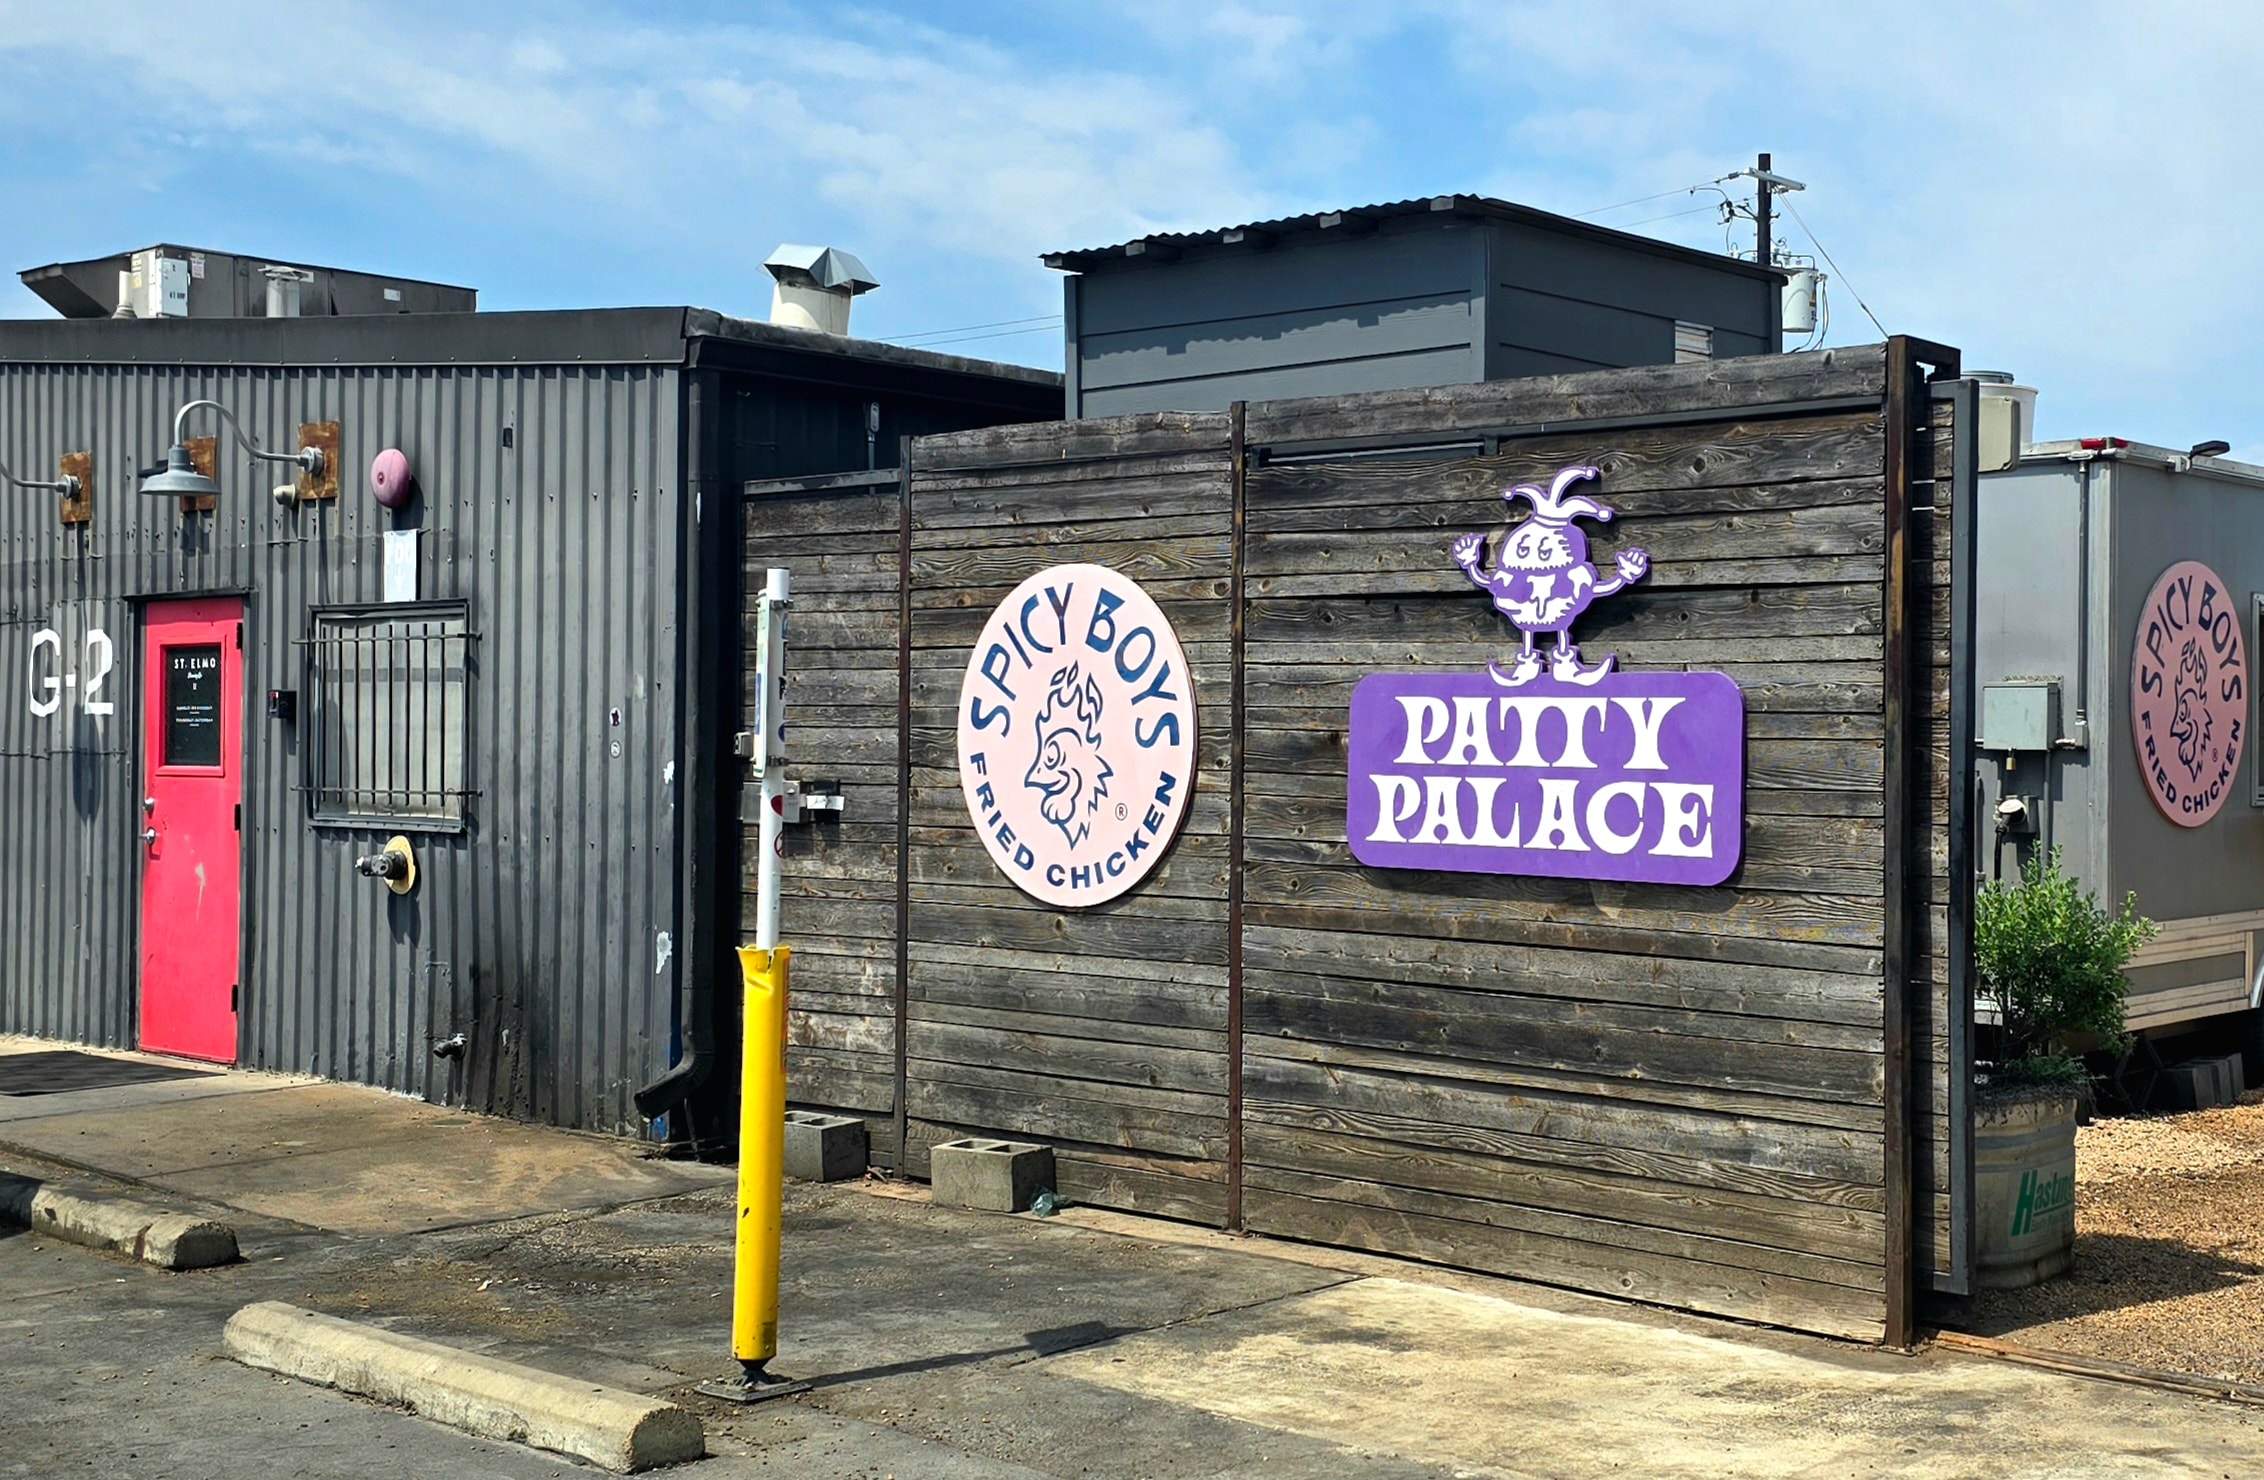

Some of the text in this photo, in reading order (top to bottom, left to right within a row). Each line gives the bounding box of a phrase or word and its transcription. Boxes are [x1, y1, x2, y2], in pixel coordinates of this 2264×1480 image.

[29, 628, 114, 718] G-2
[191, 657, 216, 669] ELMO
[971, 582, 1180, 749] SPICY BOYS
[2141, 575, 2242, 704] SPICY BOYS
[1393, 696, 1687, 771] PATTY
[2141, 710, 2241, 815] FRIED CHICKEN
[970, 752, 1178, 890] FRIED CHICKEN
[1365, 774, 1715, 859] PALACE
